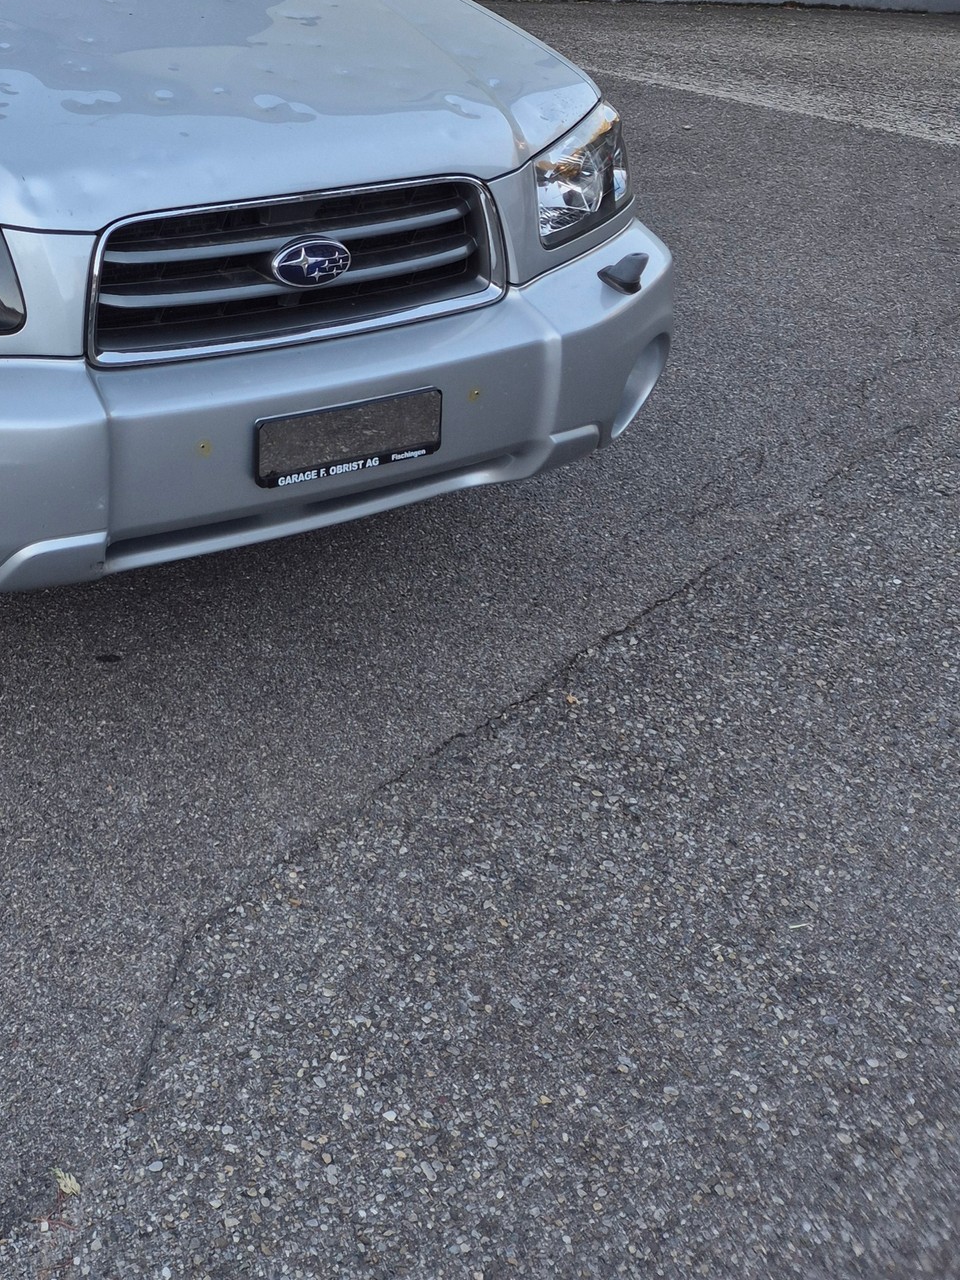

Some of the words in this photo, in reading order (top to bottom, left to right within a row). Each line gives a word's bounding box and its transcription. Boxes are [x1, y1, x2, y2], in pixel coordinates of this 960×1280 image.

[392, 449, 426, 461] Fischingen
[278, 470, 318, 486] GARAGE
[320, 468, 327, 477] F.
[330, 460, 364, 475] OBRIST
[366, 458, 380, 468] AG
